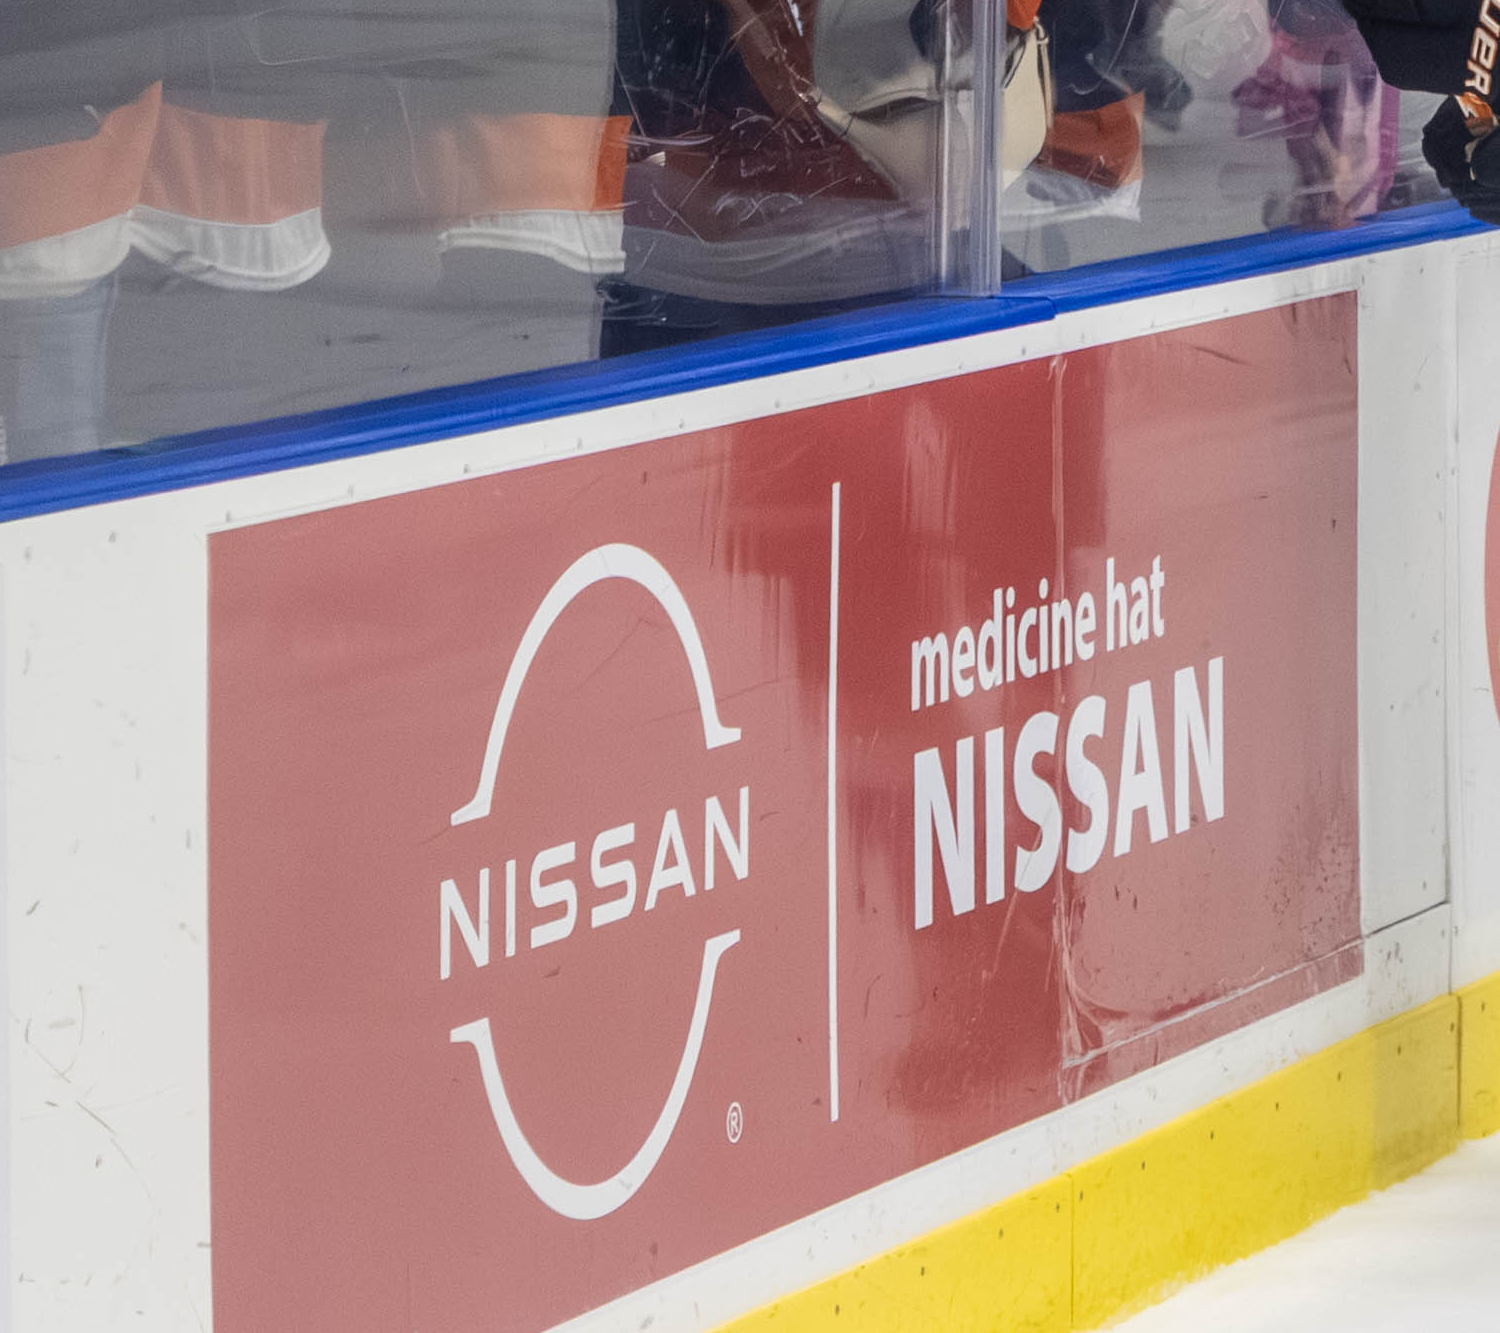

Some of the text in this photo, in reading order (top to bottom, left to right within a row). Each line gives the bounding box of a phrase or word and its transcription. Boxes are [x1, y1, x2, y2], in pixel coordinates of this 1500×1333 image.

[910, 554, 1166, 712] medicine hat
[440, 785, 751, 981] NISSAN
[913, 655, 1226, 931] NISSAN
